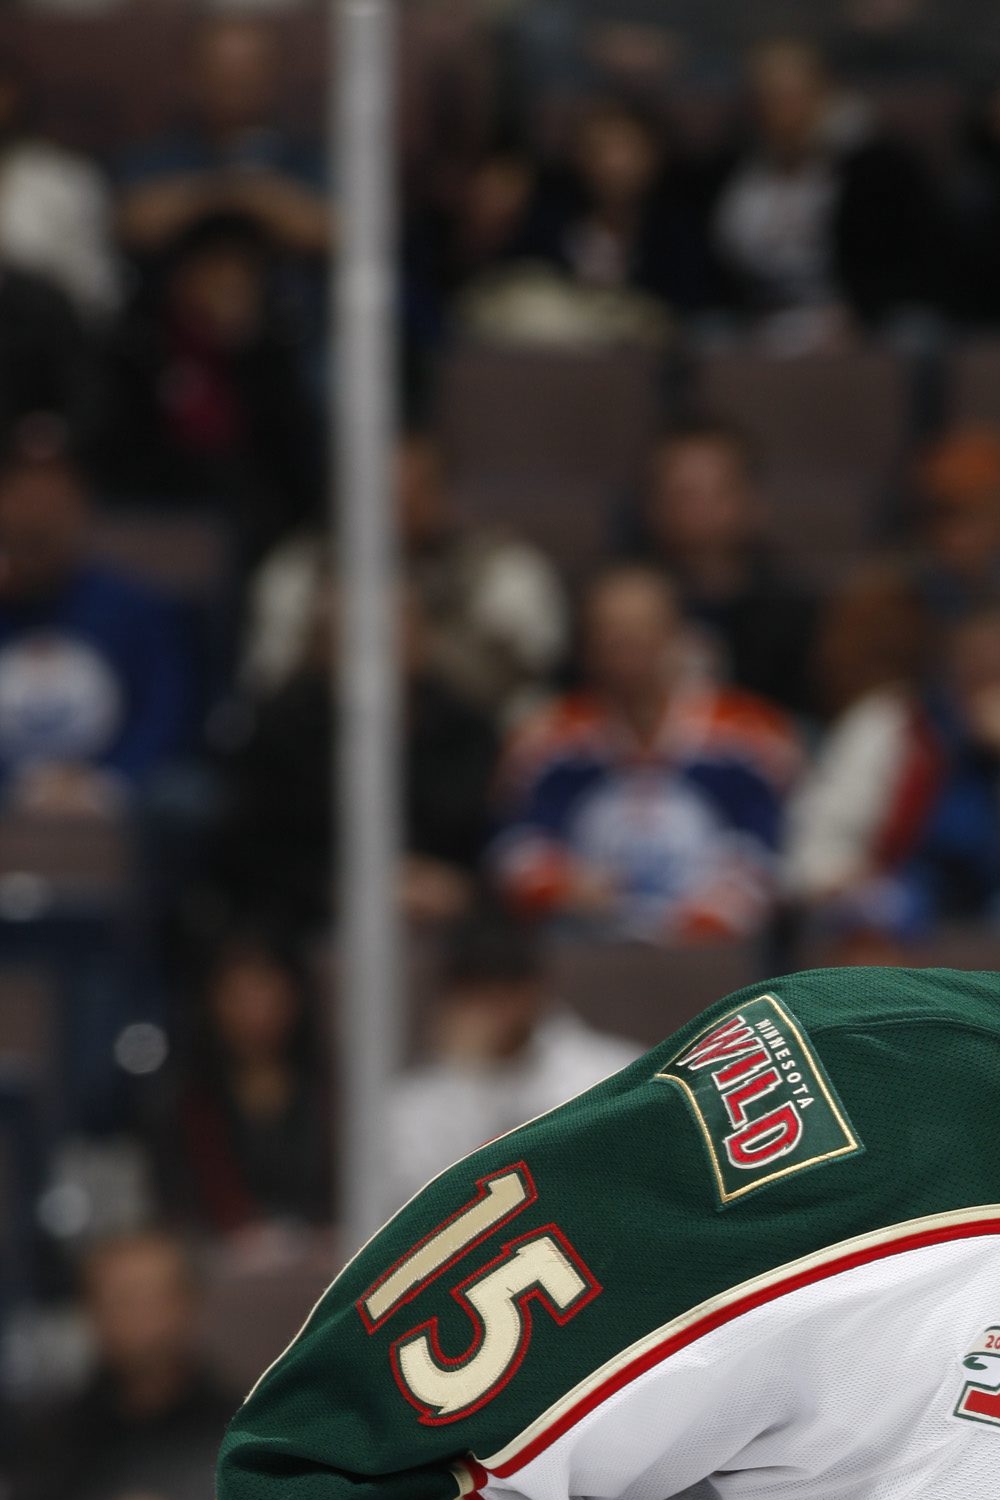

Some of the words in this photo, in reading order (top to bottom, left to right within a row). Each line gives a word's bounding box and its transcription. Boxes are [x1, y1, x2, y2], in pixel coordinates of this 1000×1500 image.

[675, 1014, 803, 1170] WILD
[754, 1018, 815, 1109] MINNESOTA
[355, 1160, 604, 1426] 15
